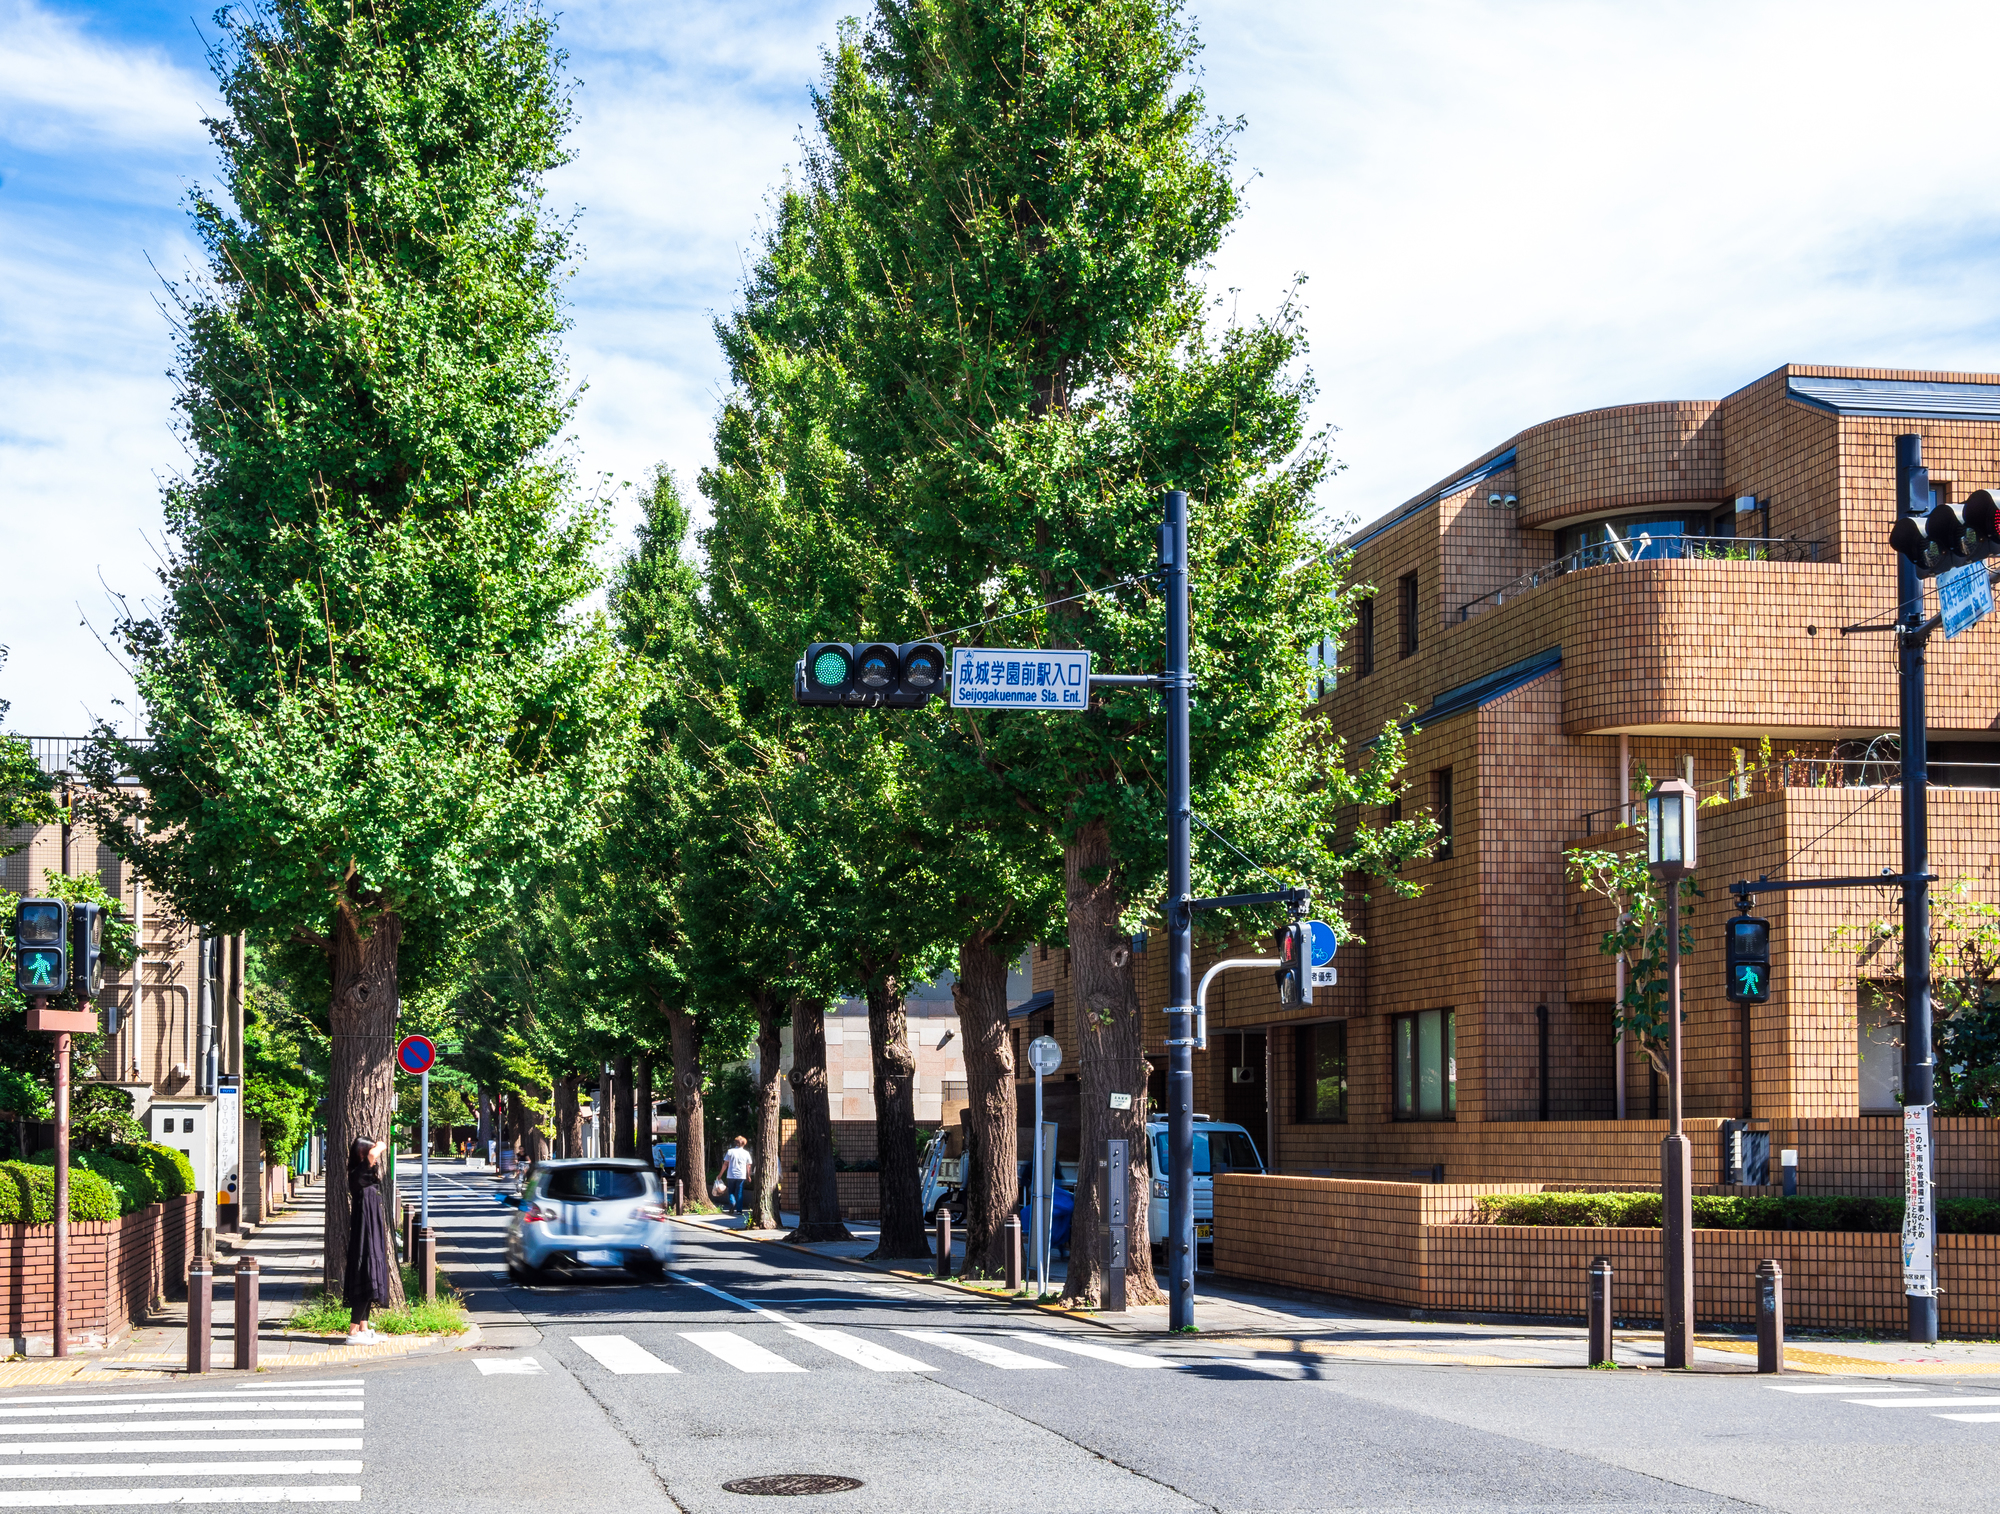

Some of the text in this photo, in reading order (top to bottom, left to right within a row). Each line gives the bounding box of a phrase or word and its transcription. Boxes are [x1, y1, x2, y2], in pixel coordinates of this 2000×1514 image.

[960, 661, 1081, 686] 成城学園前駅入口
[959, 687, 1081, 703] Seijogakuenmae Sta. Ent.
